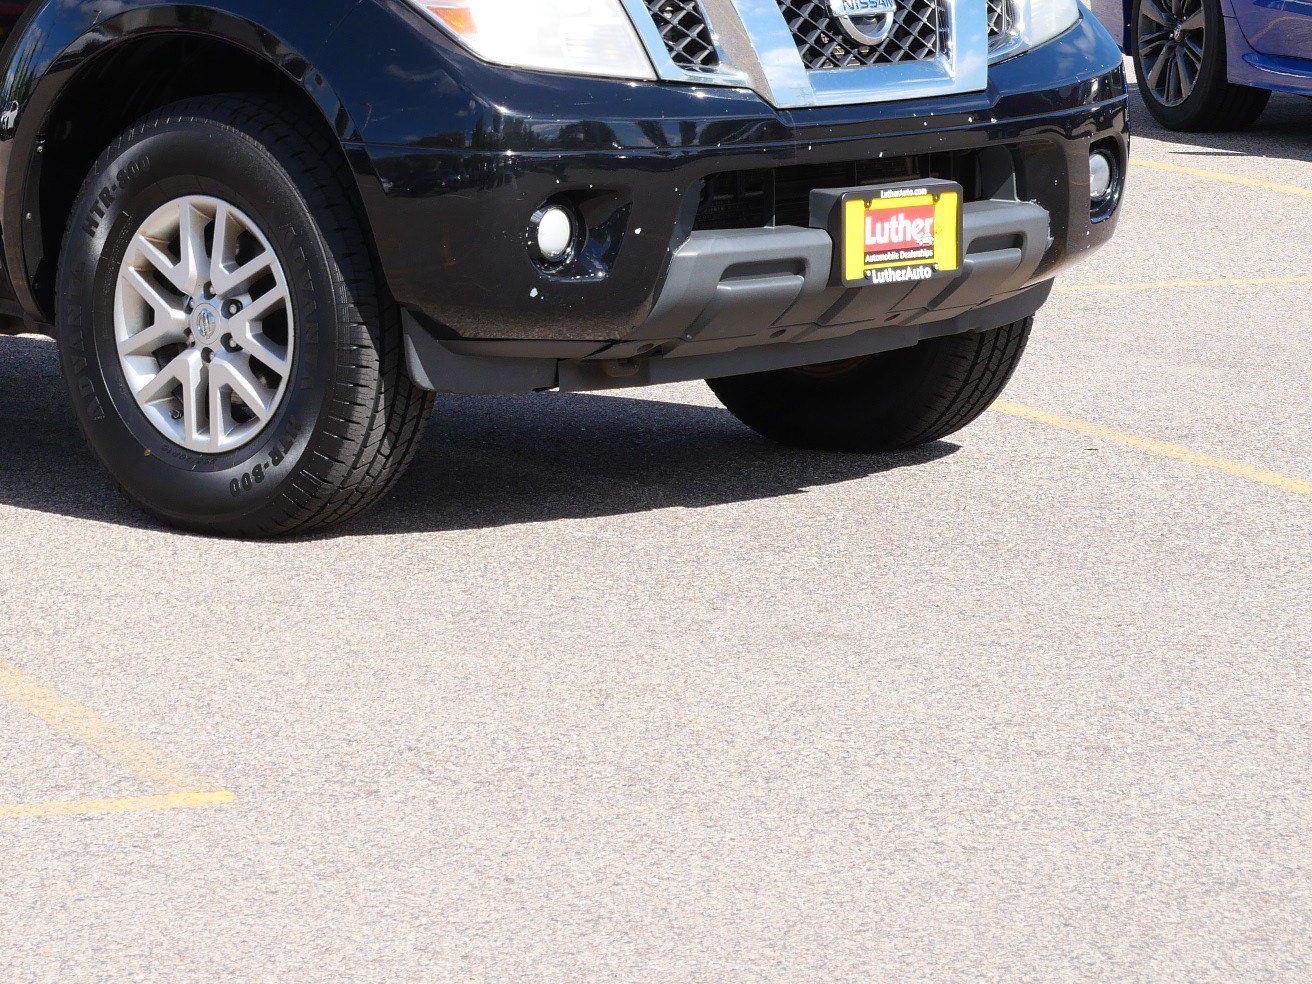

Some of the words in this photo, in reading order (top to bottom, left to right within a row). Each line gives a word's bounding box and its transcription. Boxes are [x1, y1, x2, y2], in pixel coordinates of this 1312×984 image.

[83, 154, 150, 238] HTR-800
[880, 188, 927, 198] LutherAuto.com
[865, 213, 934, 246] Luther
[865, 251, 899, 263] Automobile
[900, 248, 934, 260] Dealerships
[872, 265, 932, 284] LutherAuto
